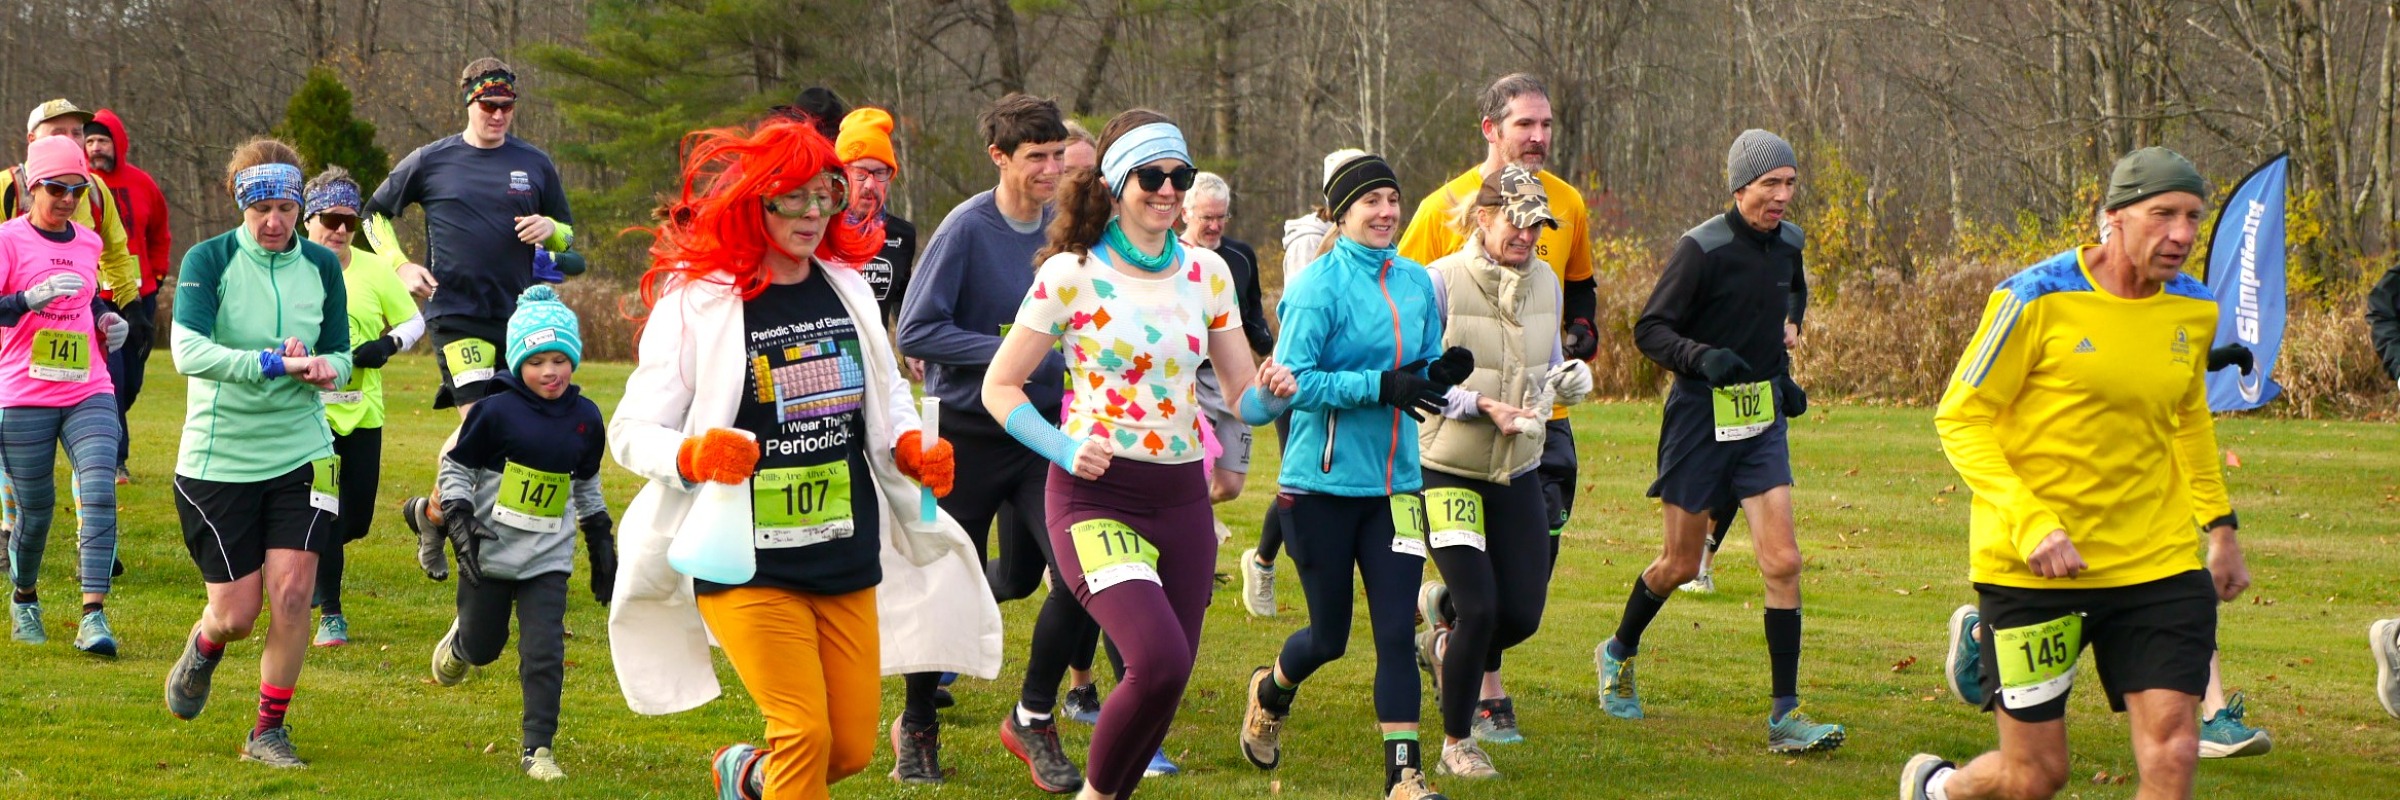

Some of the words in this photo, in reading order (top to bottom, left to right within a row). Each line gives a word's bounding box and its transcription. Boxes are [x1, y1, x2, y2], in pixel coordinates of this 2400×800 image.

[50, 259, 74, 267] TEAM
[751, 325, 790, 342] Periodic
[789, 321, 815, 333] Table
[816, 319, 825, 329] of
[49, 339, 78, 362] 141
[461, 345, 482, 365] 95
[1731, 394, 1761, 418] 102
[782, 424, 786, 435] I
[788, 419, 821, 434] Wear
[520, 479, 558, 508] 147
[781, 479, 829, 516] 107
[1443, 498, 1476, 524] 123
[1097, 530, 1140, 556] 117
[2019, 632, 2067, 673] 145
